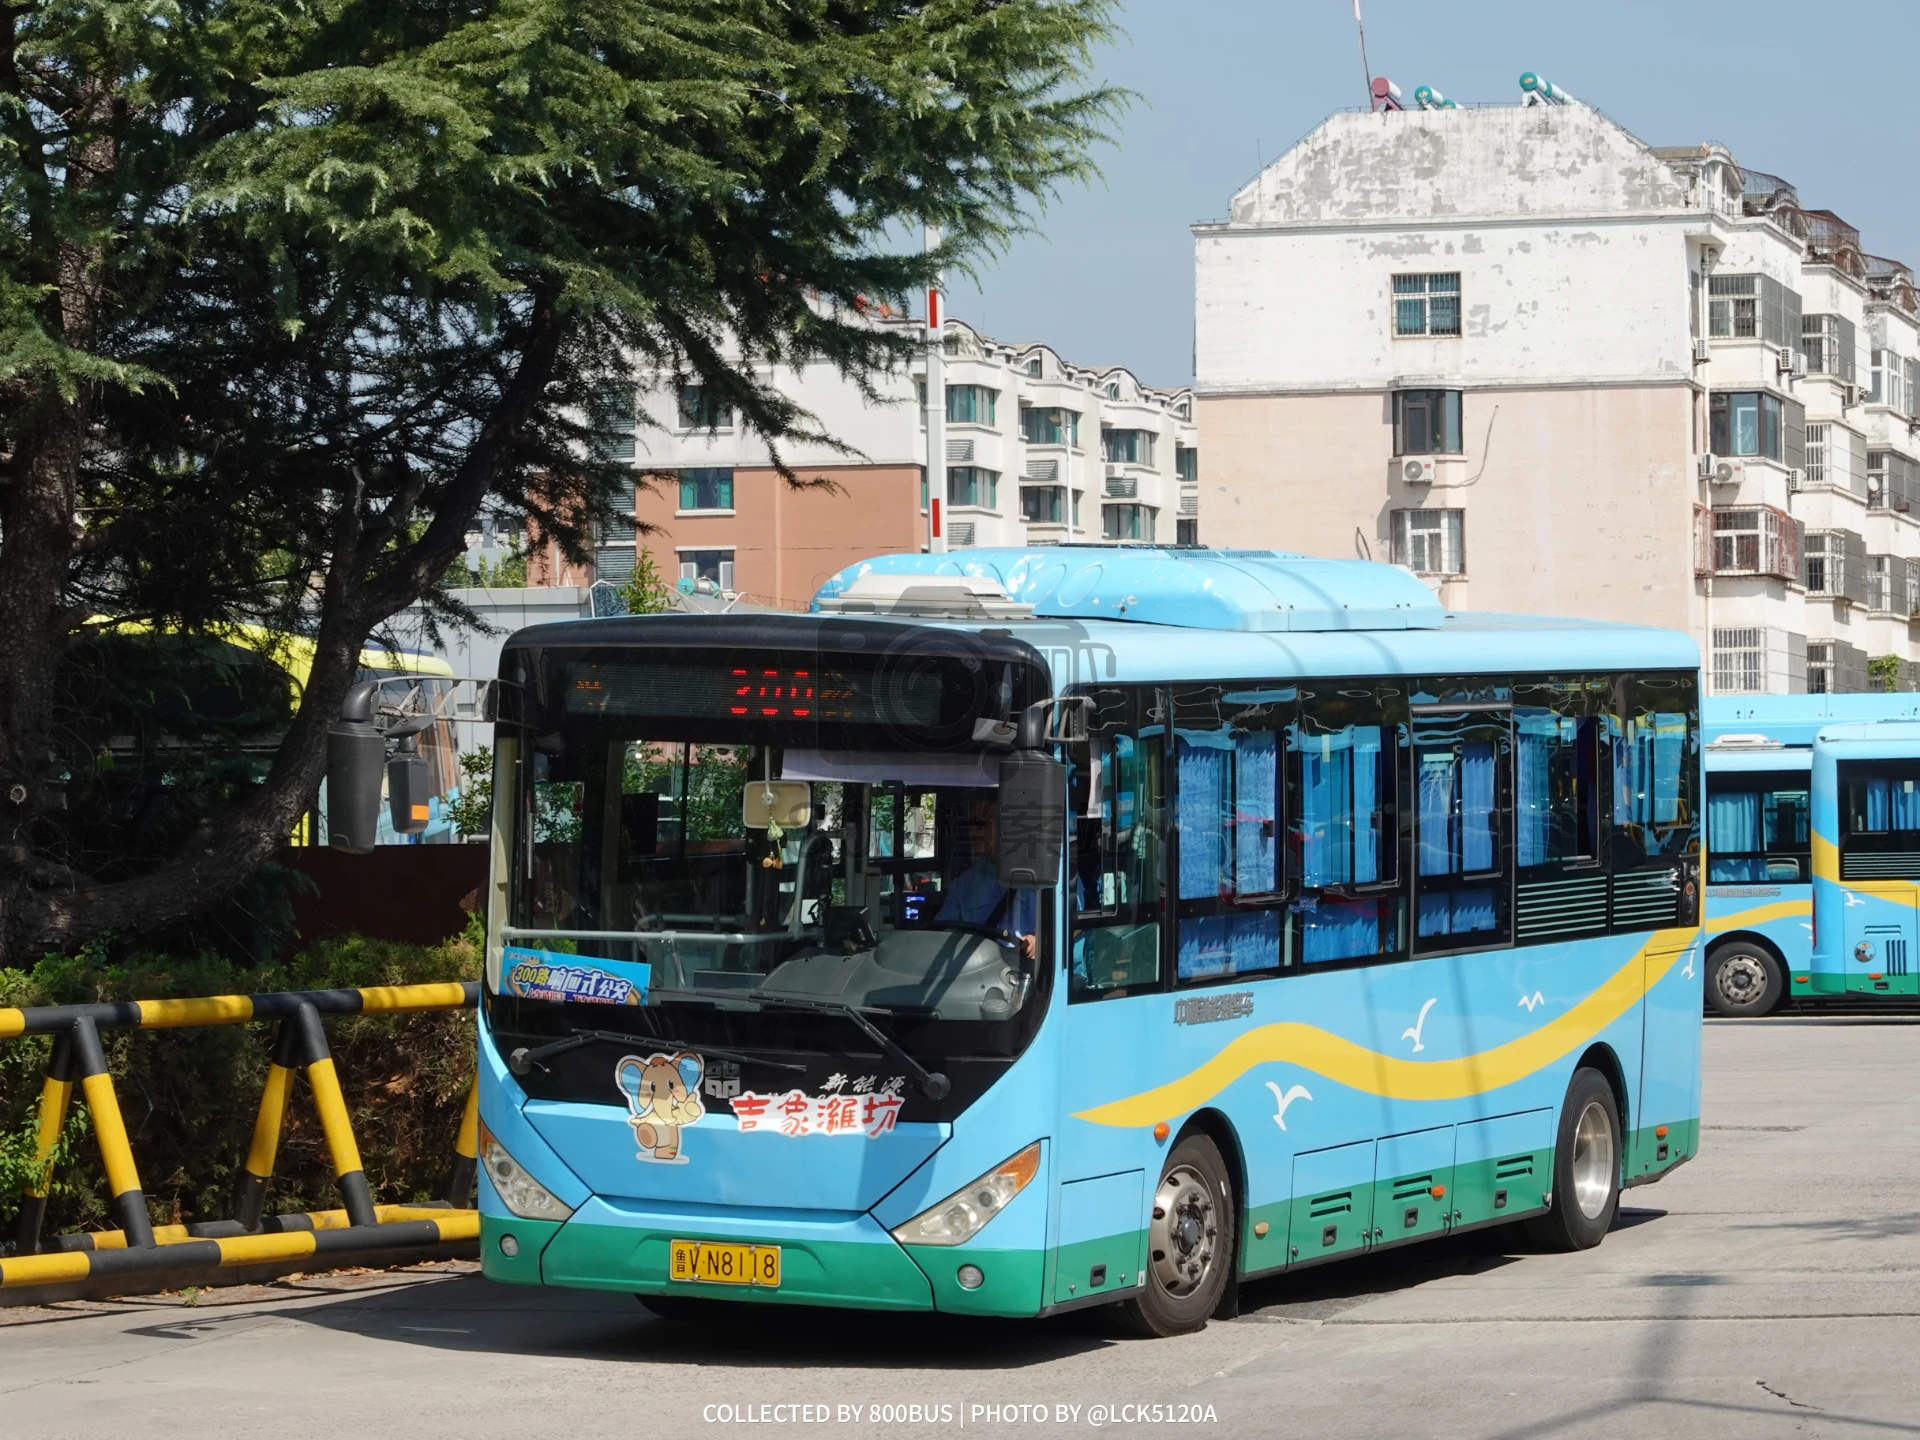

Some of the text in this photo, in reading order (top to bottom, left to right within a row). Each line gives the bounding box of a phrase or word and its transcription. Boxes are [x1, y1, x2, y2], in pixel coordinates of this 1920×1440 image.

[514, 966, 631, 1001] 300路响应式公交
[820, 1072, 906, 1094] 新能源
